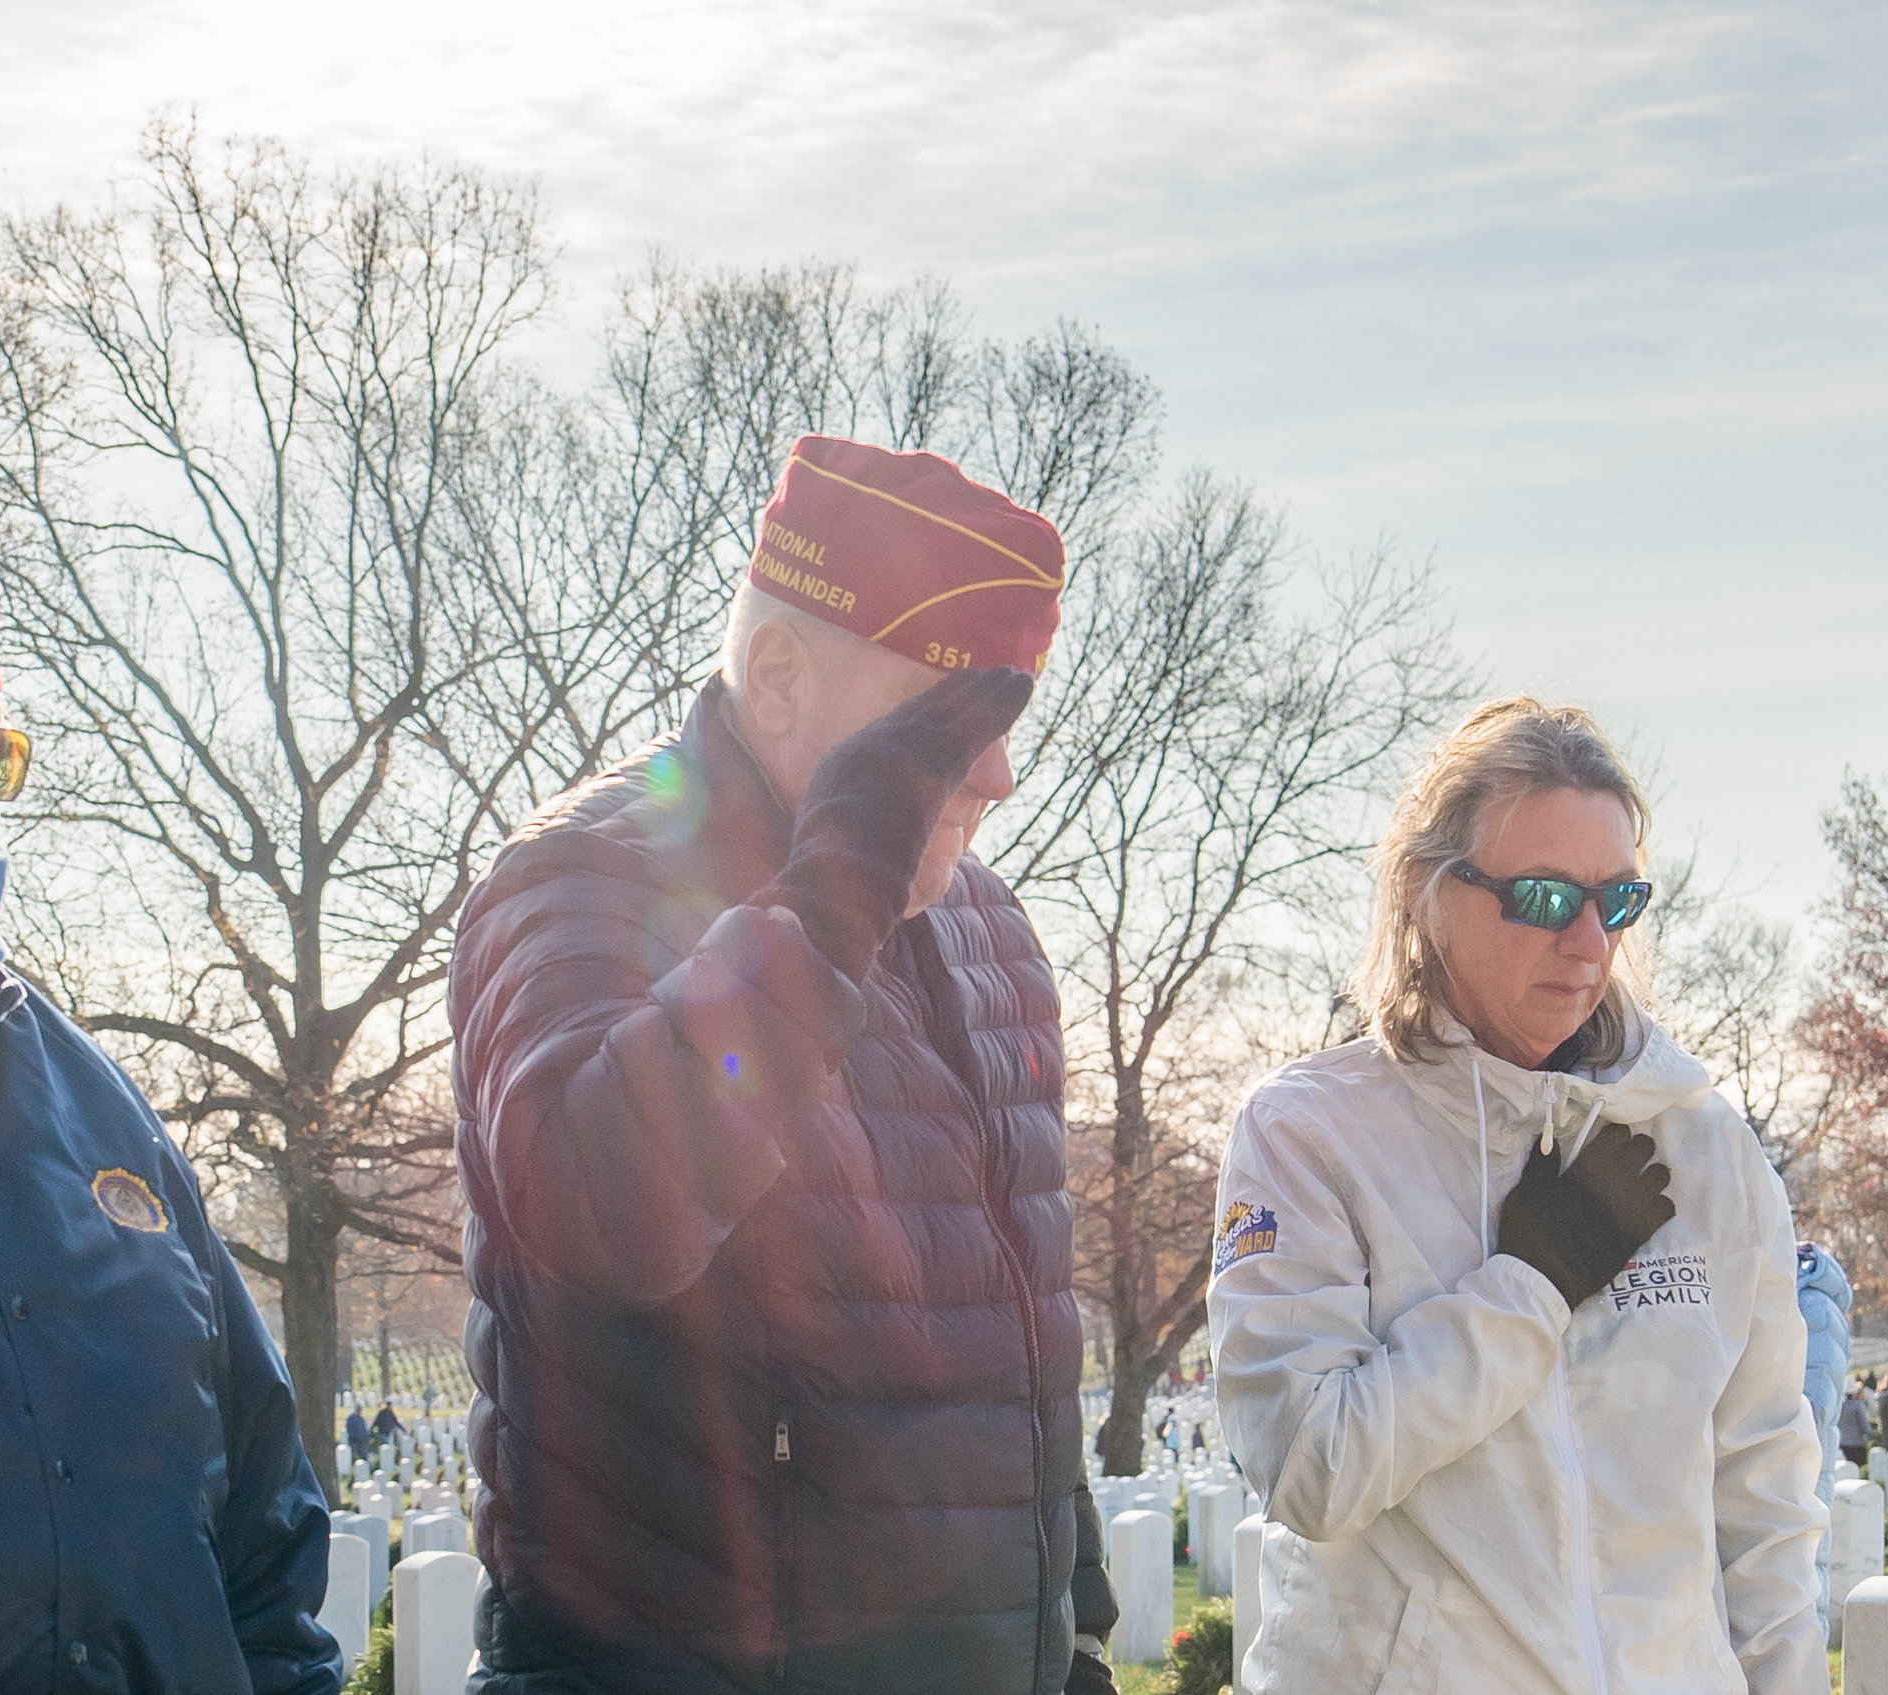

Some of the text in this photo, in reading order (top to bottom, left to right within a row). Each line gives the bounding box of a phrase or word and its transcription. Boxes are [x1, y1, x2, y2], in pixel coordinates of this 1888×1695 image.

[754, 550, 857, 614] COMMANDER
[925, 642, 972, 669] 351
[1638, 1256, 1706, 1269] AMERICAN
[1610, 1267, 1709, 1293] LEGION
[1614, 1287, 1710, 1311] FAMILY
